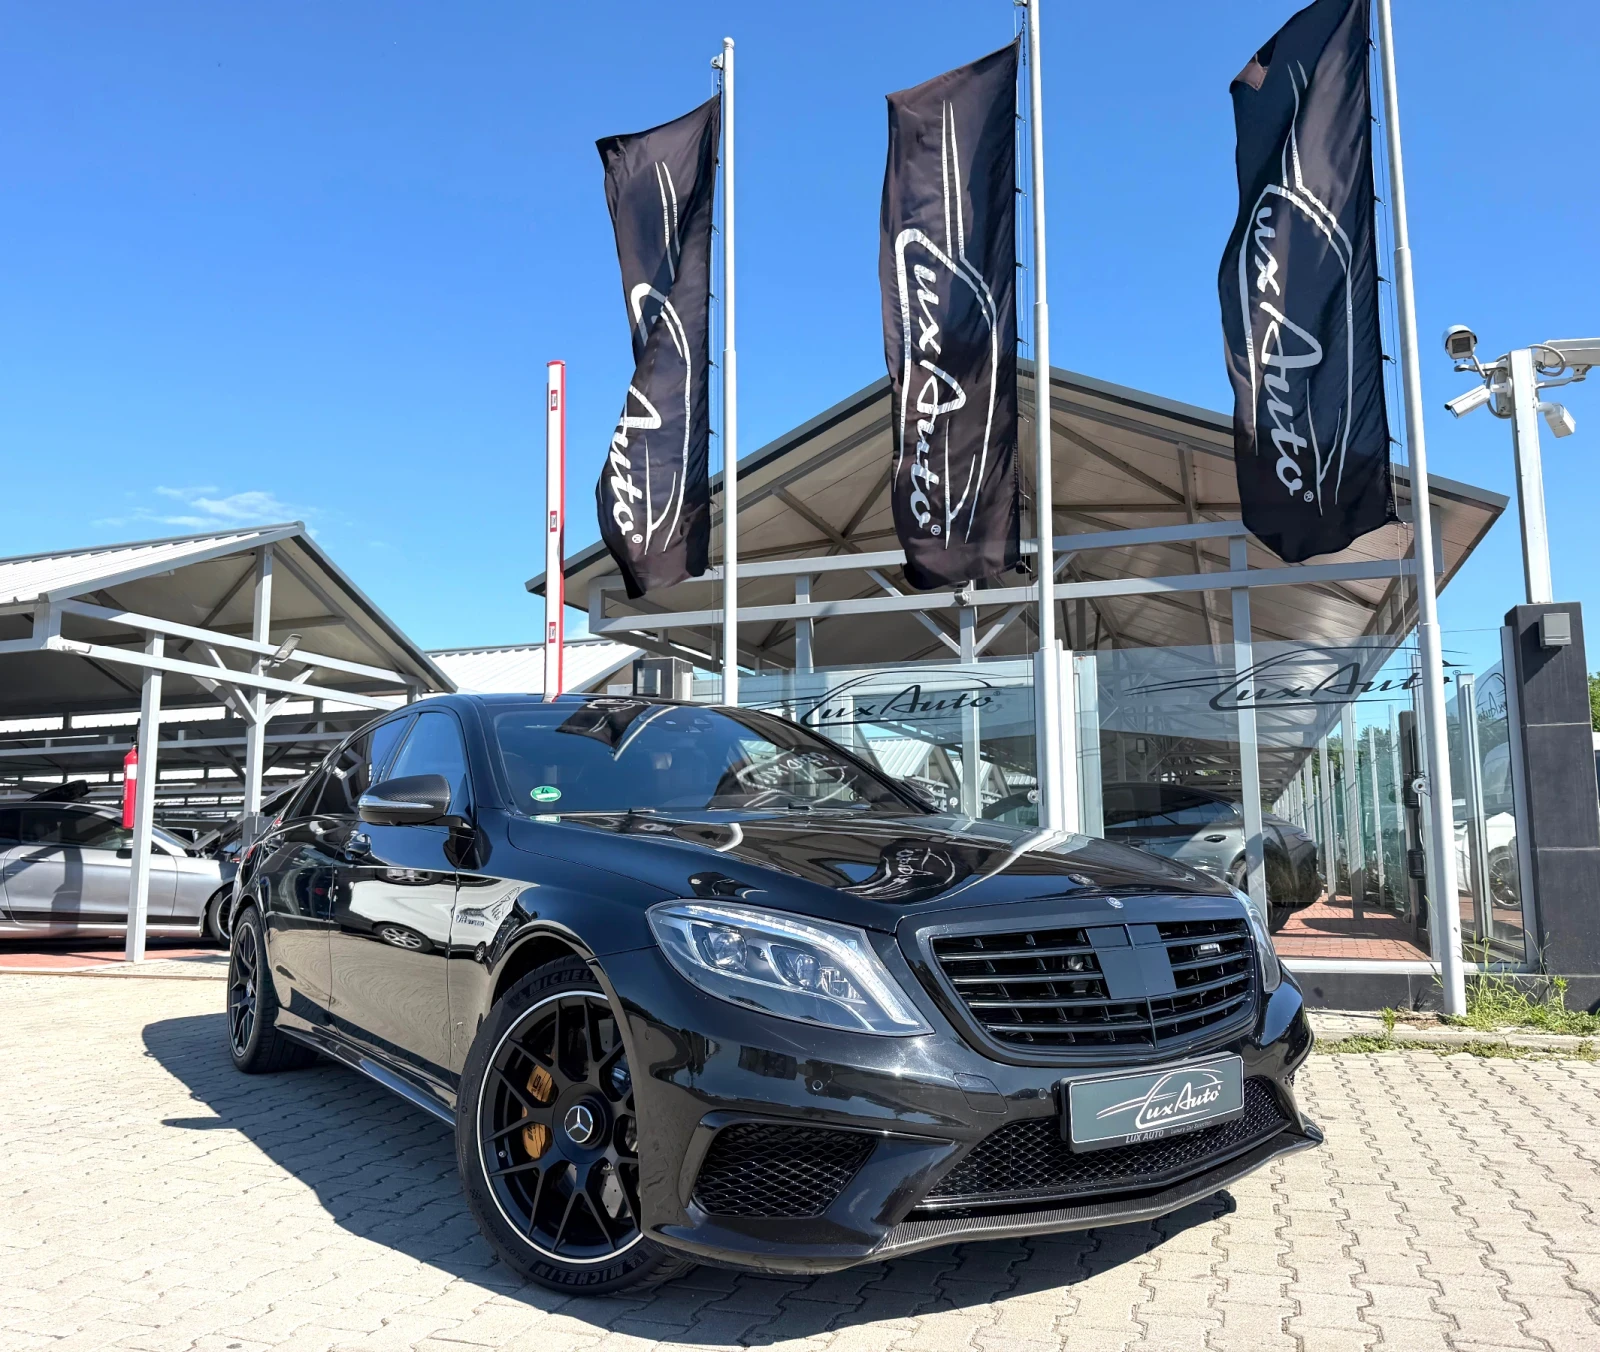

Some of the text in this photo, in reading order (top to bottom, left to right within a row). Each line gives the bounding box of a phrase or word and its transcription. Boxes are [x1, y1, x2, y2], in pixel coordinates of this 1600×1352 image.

[528, 968, 597, 995] MICHEL
[1125, 1133, 1141, 1144] LUX
[1143, 1129, 1164, 1141] AUTO
[505, 1245, 526, 1264] PILOT
[534, 1262, 625, 1285] MICHELIN
